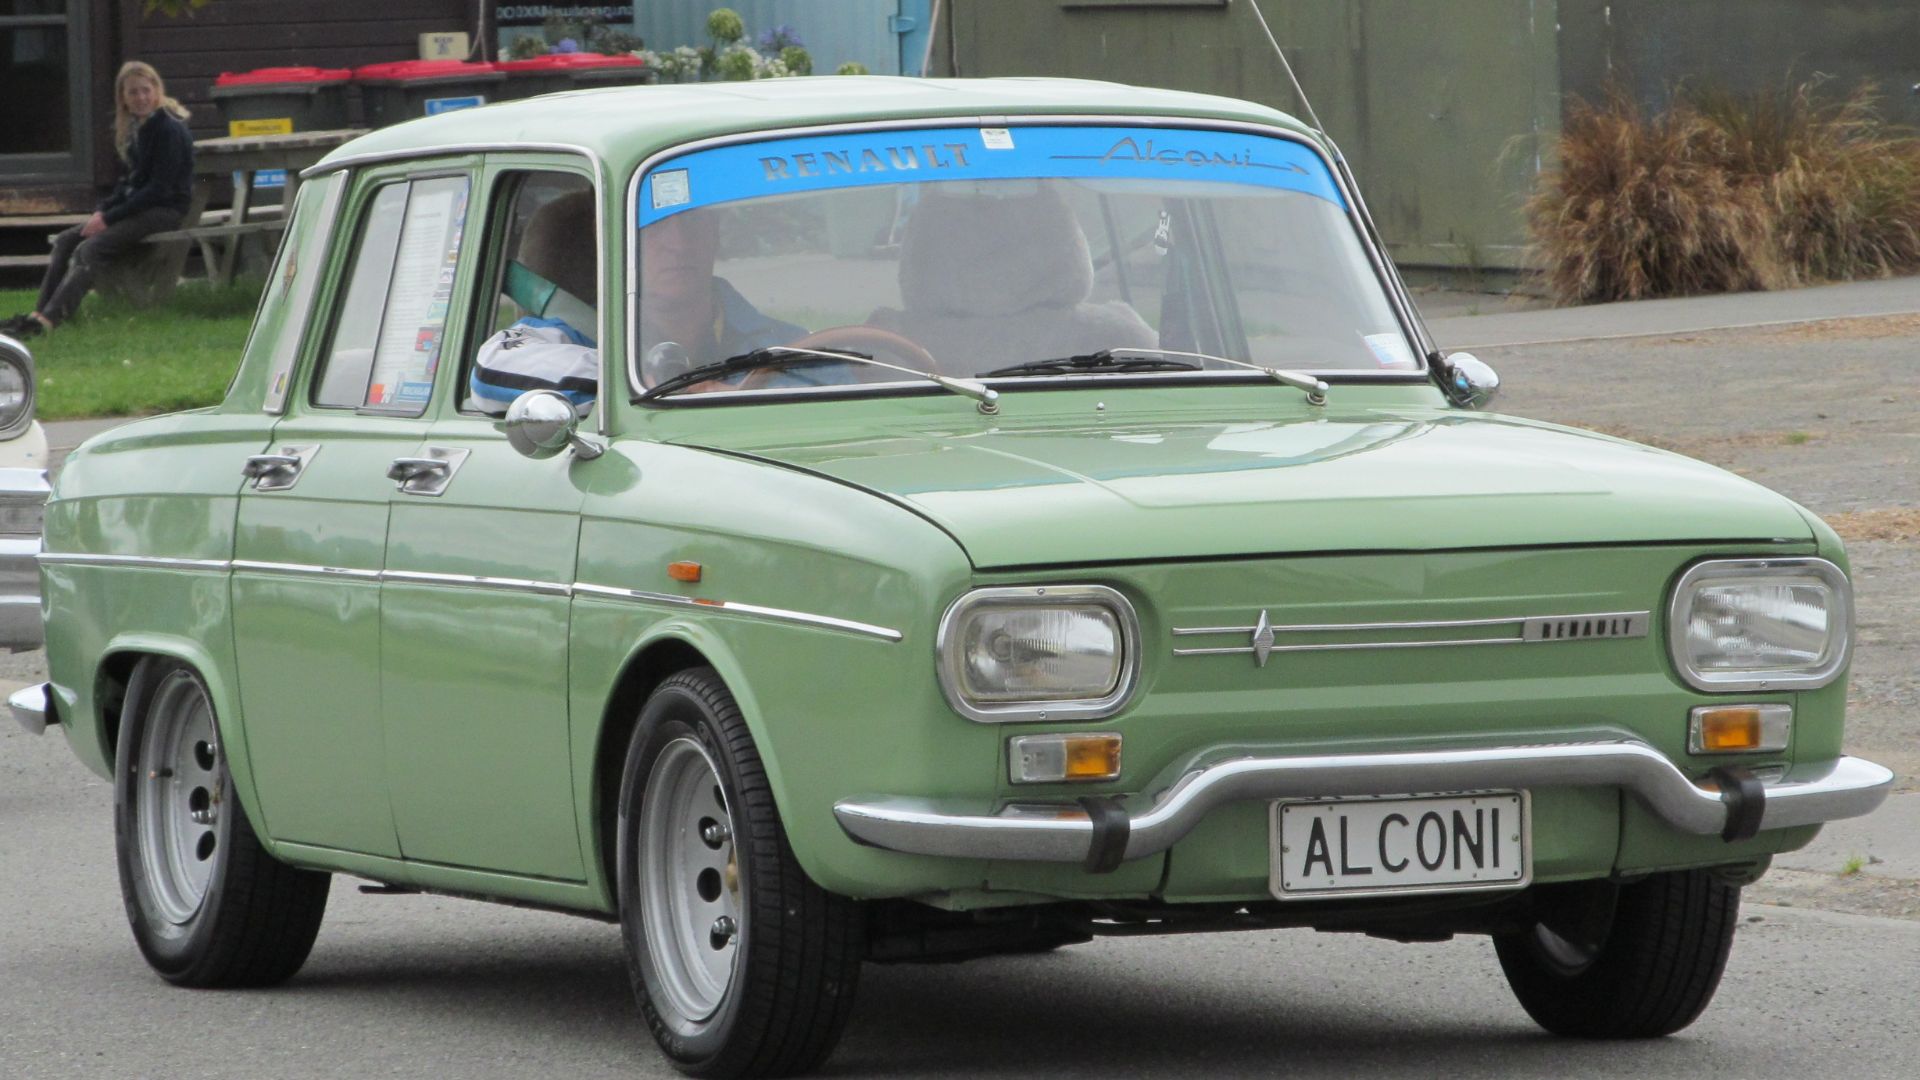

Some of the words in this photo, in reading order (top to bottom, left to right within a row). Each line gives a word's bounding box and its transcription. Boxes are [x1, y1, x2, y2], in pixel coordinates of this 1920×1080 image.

[758, 143, 971, 181] RENAULT
[1541, 617, 1632, 639] RENAULT
[1302, 807, 1500, 877] ALCONI
